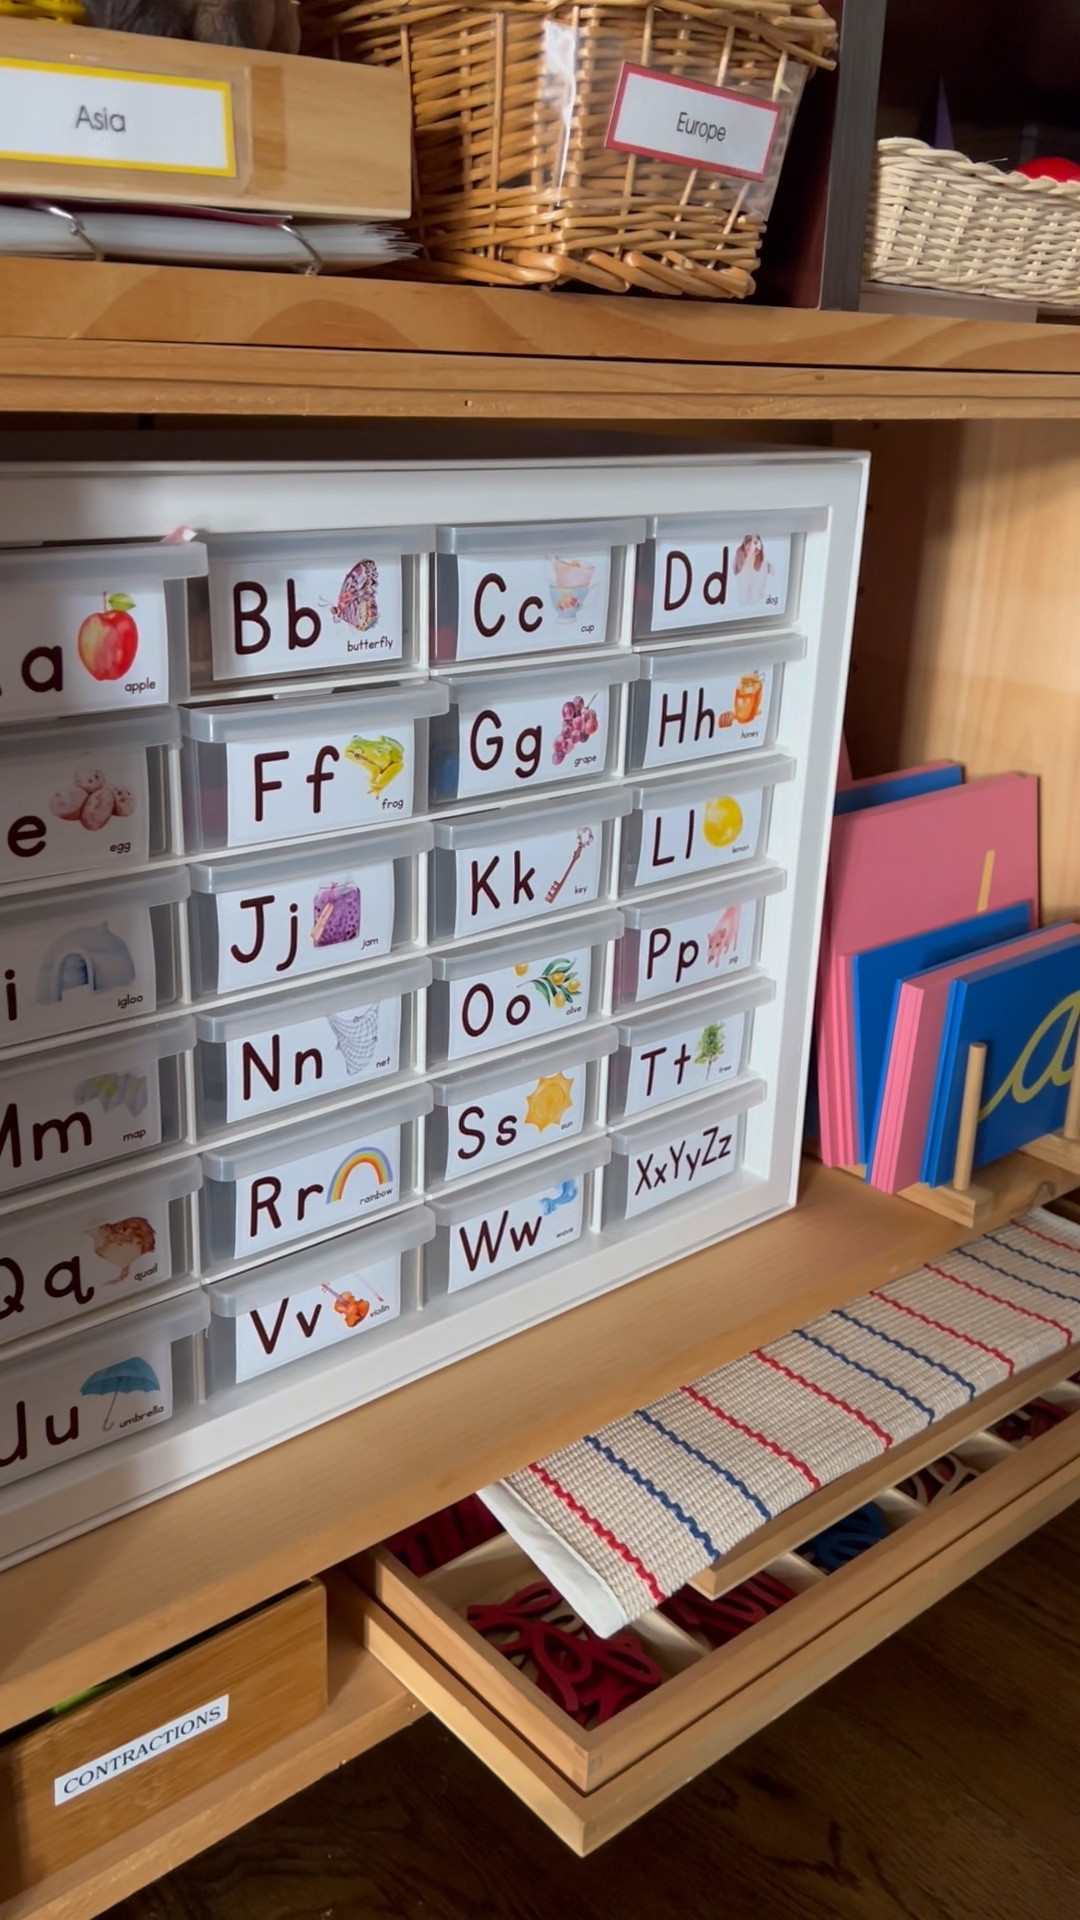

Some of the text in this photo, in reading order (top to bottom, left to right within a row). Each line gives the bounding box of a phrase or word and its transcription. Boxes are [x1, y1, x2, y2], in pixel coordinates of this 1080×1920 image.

[75, 105, 126, 132] Asia
[676, 112, 726, 142] Europe
[664, 545, 729, 611] Dd
[474, 573, 544, 637] Cc
[765, 594, 779, 606] dog
[233, 578, 322, 655] Bb
[581, 623, 595, 635] cup
[347, 637, 393, 652] butterfly
[124, 677, 156, 695] apple
[658, 687, 715, 747] Hh
[470, 710, 543, 778] Gg
[740, 729, 759, 740] honey
[574, 754, 597, 767] grape
[254, 745, 340, 822] Ff
[382, 798, 404, 810] frog
[6, 815, 47, 857] e
[110, 841, 131, 854] egg
[471, 850, 535, 916] Kk
[574, 885, 588, 895] key
[230, 895, 298, 971] Jj
[360, 935, 379, 950] jam
[646, 927, 699, 983] Pp
[4, 969, 17, 1021] i
[117, 993, 144, 1009] igloo
[565, 1004, 582, 1016] olive
[242, 1034, 323, 1101] Nn
[375, 1055, 391, 1069] net
[640, 1043, 692, 1097] Tt
[123, 1129, 147, 1142] map
[561, 1121, 574, 1130] sun
[359, 1187, 394, 1205] rainbow
[250, 1176, 324, 1237] Rr
[133, 1263, 158, 1281] quail
[369, 1304, 390, 1318] violin
[119, 1405, 164, 1428] umbrella
[63, 1706, 221, 1794] CONTRACTIONS
